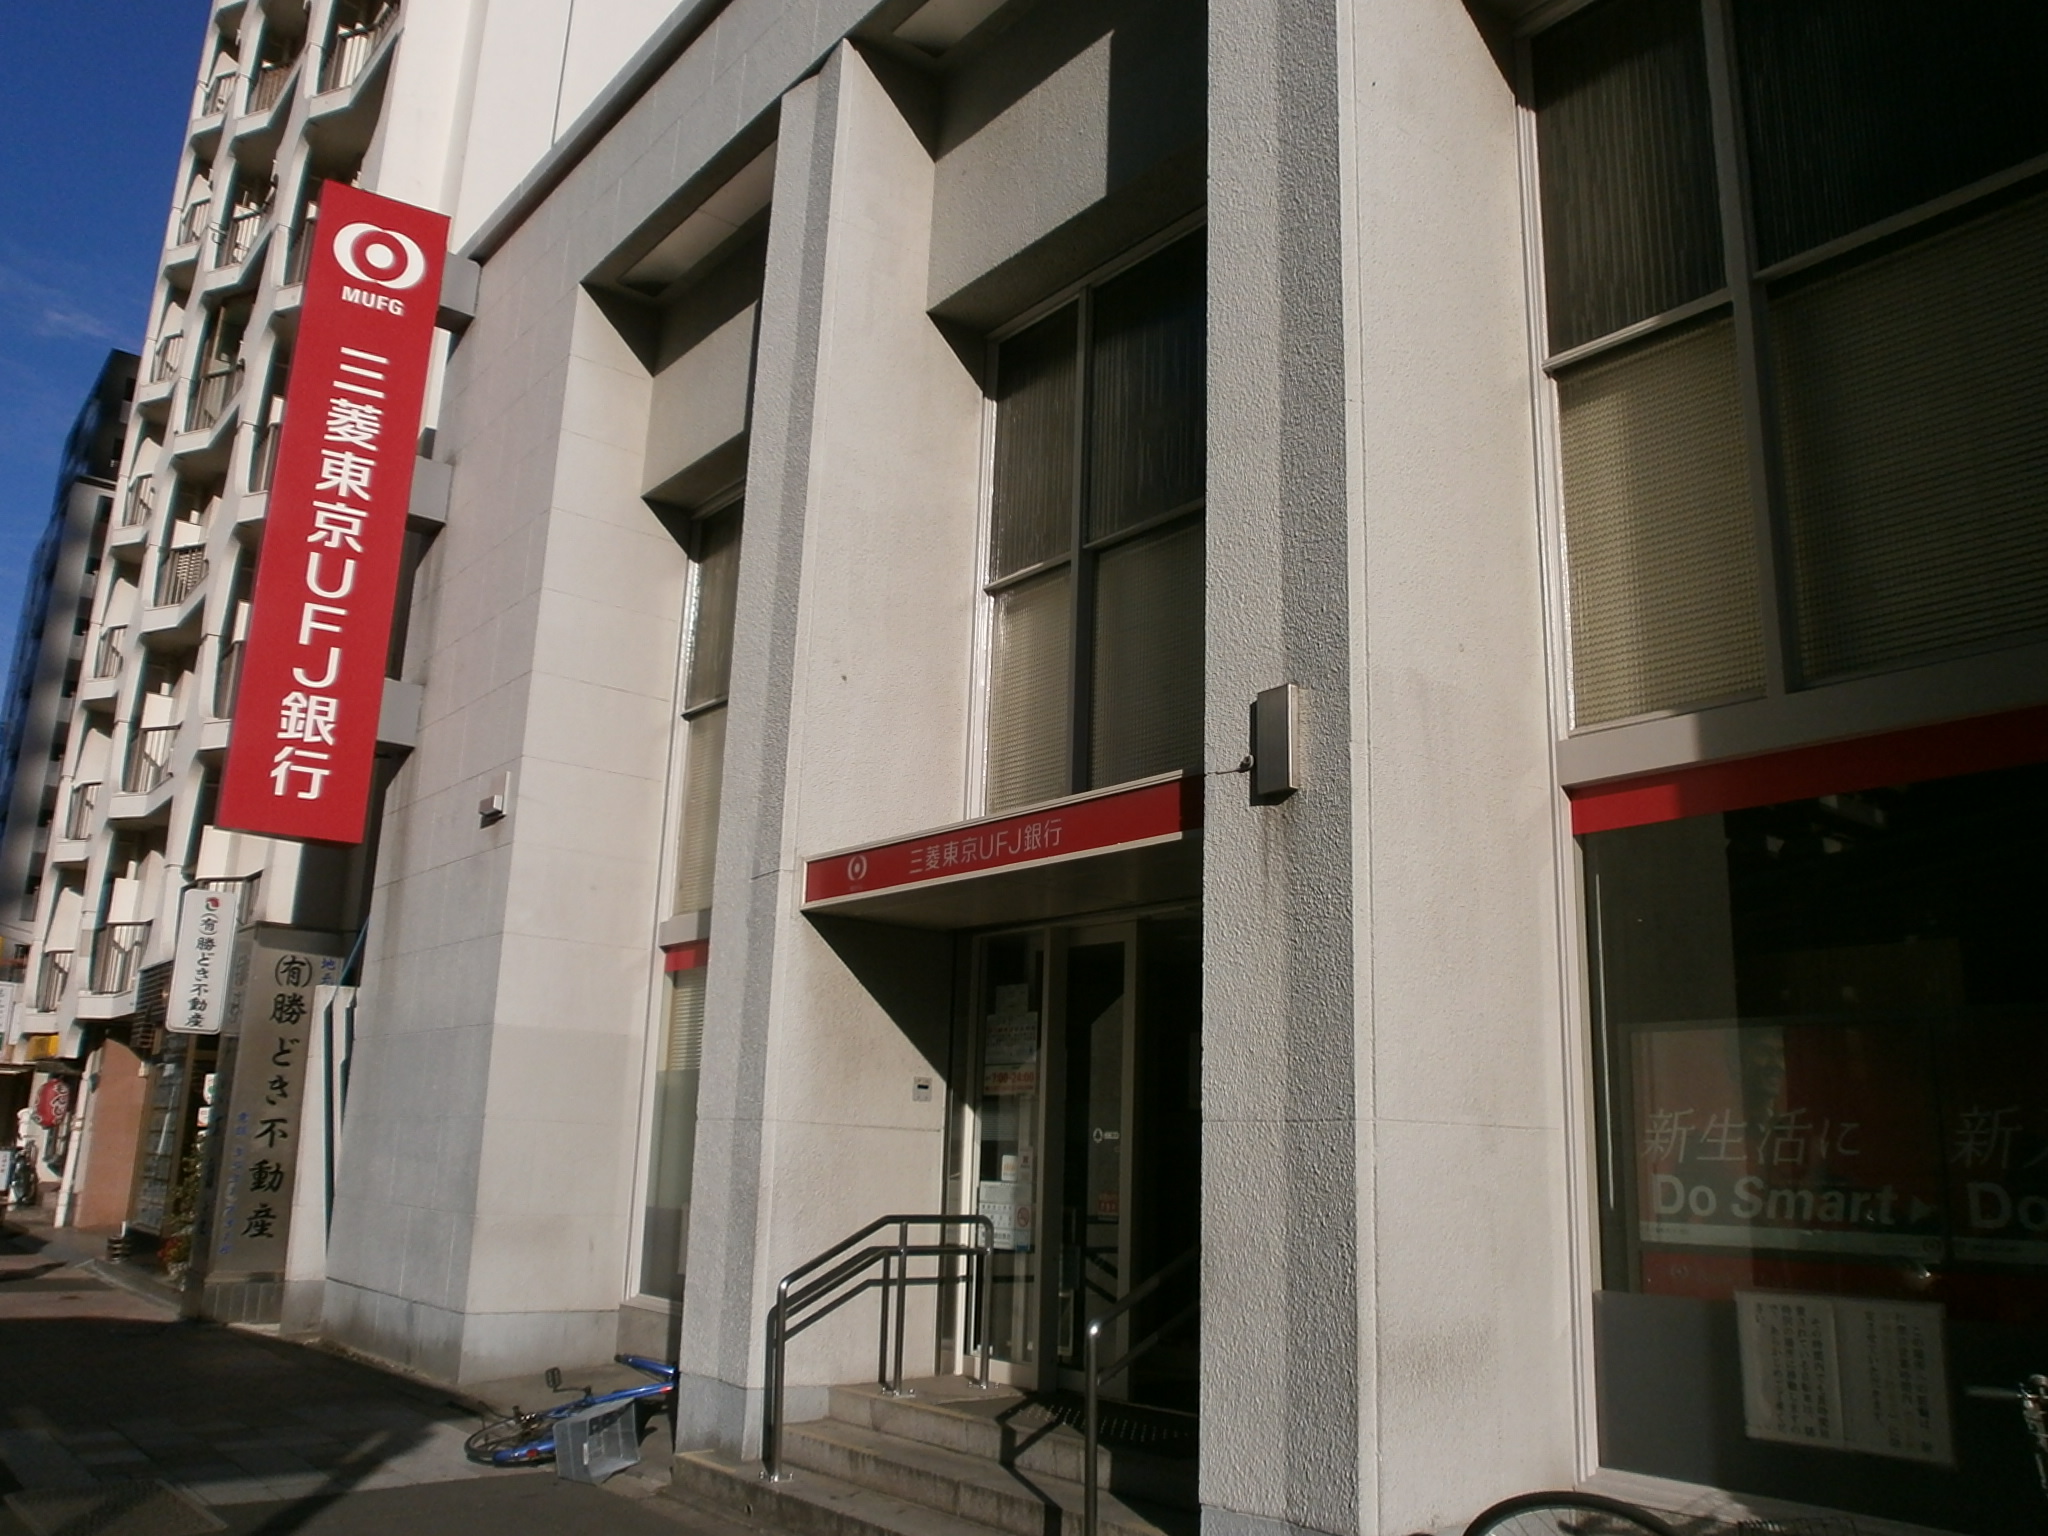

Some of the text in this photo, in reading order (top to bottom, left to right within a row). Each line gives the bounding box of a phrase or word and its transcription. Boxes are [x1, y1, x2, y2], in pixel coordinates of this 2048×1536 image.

[341, 286, 404, 317] MUFG
[270, 346, 390, 799] 三菱東京UFJ銀行
[909, 819, 1062, 875] 三菱東京UFJ銀行
[1642, 1106, 1861, 1166] 新生活に
[1653, 1172, 1899, 1226] Do Smart
[1966, 1181, 2048, 1232] Do
